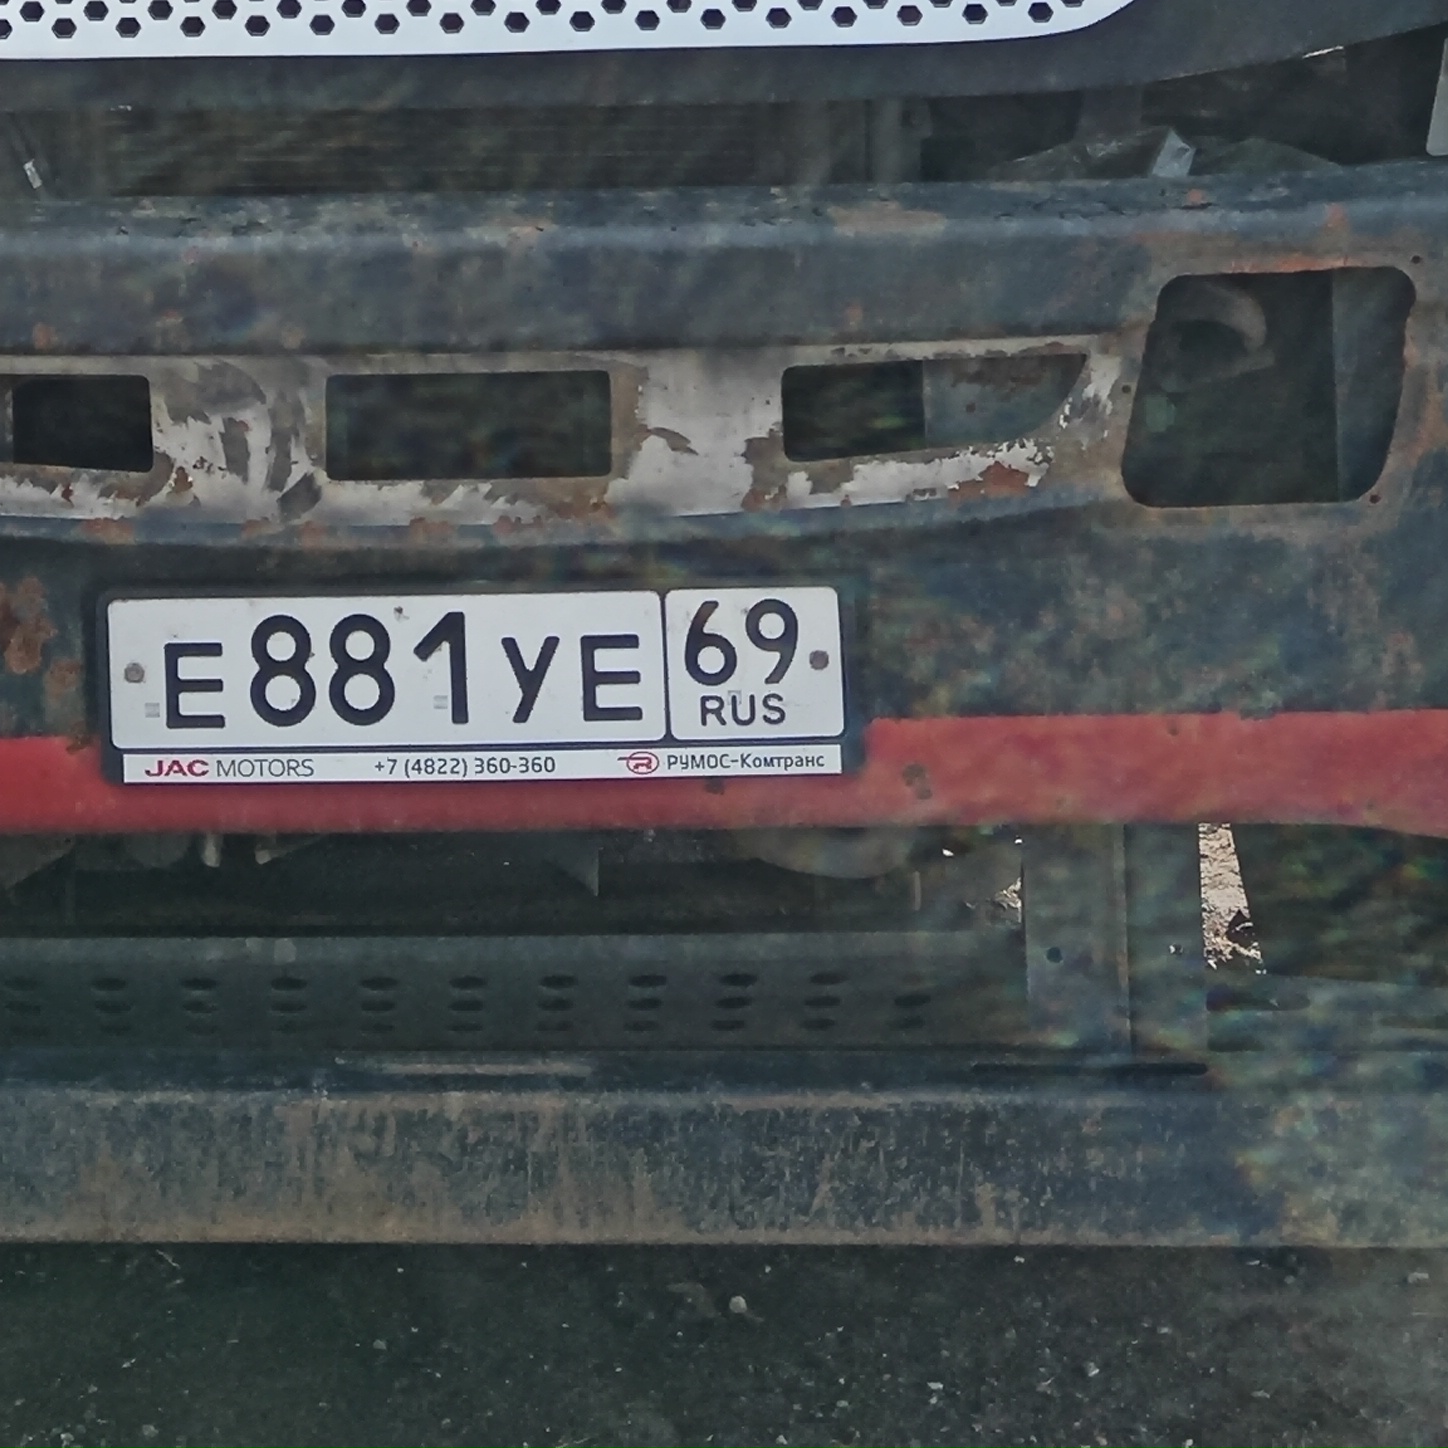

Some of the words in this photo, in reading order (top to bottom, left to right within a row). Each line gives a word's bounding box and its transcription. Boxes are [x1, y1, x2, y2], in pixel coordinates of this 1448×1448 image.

[683, 598, 800, 686] 69
[700, 692, 788, 728] RUS
[144, 758, 210, 778] JAC
[215, 758, 315, 778] MOTORS
[374, 757, 398, 775] +7
[404, 757, 469, 779] (4822)
[473, 756, 557, 775] 360-360
[666, 752, 826, 772] РУМОС-Комтранс
